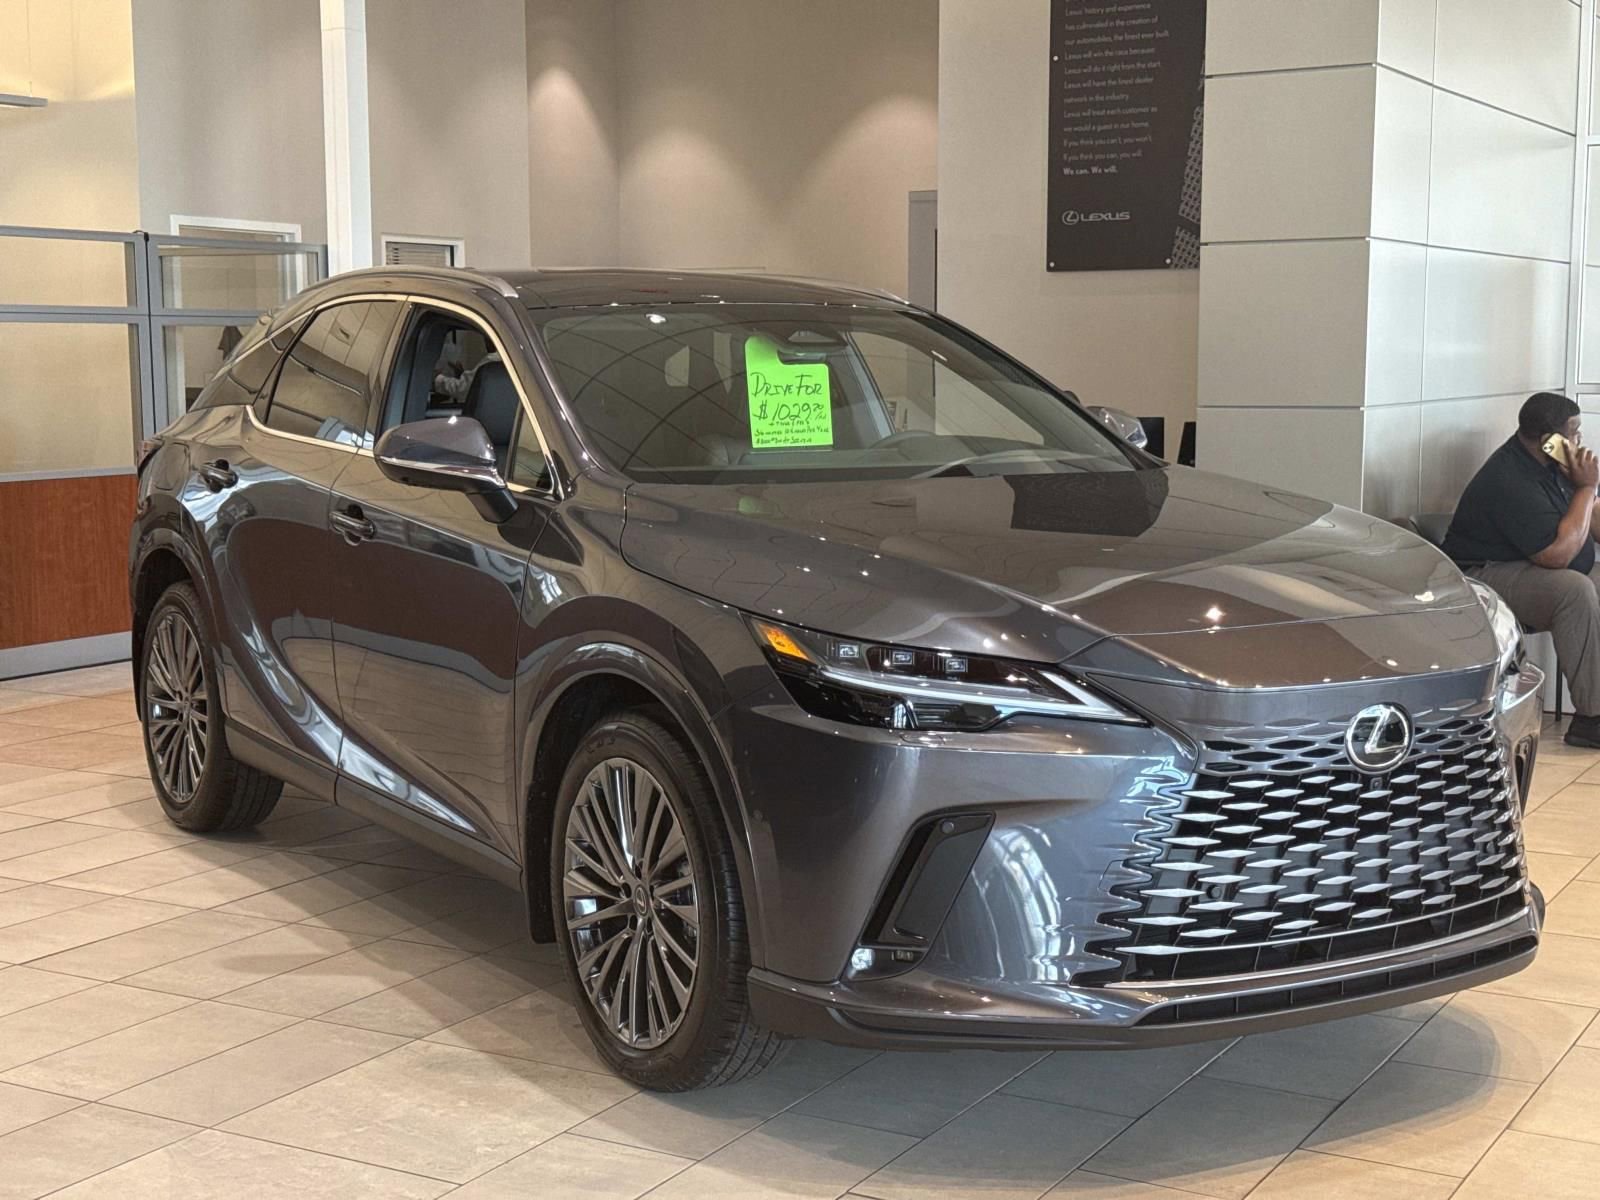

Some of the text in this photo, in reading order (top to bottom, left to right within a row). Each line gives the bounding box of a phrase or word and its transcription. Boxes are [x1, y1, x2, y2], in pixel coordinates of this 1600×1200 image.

[1105, 4, 1117, 13] and
[1115, 18, 1125, 26] the
[1126, 17, 1151, 26] creation
[1152, 15, 1158, 23] of
[1113, 33, 1124, 41] the
[1065, 51, 1082, 60] Lexus
[1083, 50, 1092, 58] will
[1104, 48, 1114, 57] the
[1135, 61, 1146, 69] the
[1064, 81, 1081, 89] Lexus
[1082, 79, 1092, 87] will
[1107, 78, 1117, 86] the
[1094, 93, 1105, 102] the
[1064, 110, 1081, 118] Lexus
[1081, 109, 1091, 117] will
[1122, 106, 1149, 115] customer
[1068, 140, 1079, 148] you
[1080, 137, 1094, 145] think
[1068, 154, 1079, 162] you
[1080, 151, 1094, 160] think
[1063, 166, 1074, 175] We
[1090, 165, 1102, 174] We
[1080, 211, 1131, 222] LEXUS
[751, 371, 823, 397] DRIVE FOR
